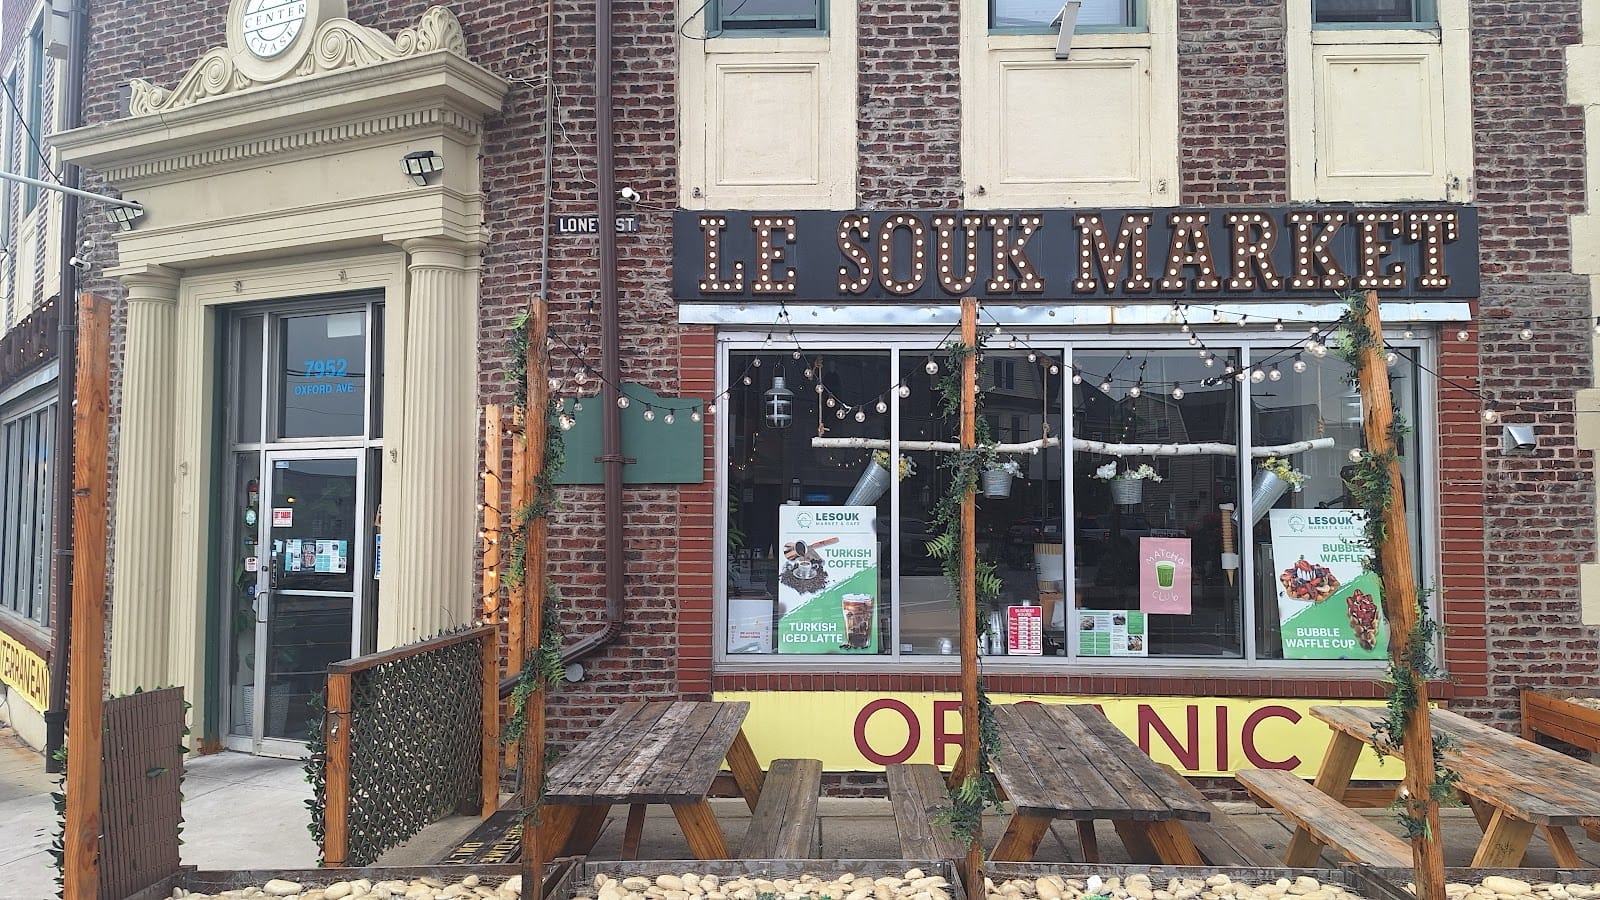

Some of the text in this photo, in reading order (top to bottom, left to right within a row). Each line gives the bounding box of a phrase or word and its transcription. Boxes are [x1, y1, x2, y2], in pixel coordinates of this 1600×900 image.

[245, 4, 305, 28] CENTER
[250, 27, 296, 53] CHASE
[615, 217, 637, 232] ST.
[699, 209, 1459, 295] LE SOUK MARKET
[304, 356, 347, 378] 7952
[294, 383, 332, 396] OXFORD
[815, 512, 860, 521] LESOUK
[1308, 516, 1353, 525] LESOUK
[1322, 543, 1365, 552] BUBBLE
[825, 548, 872, 558] TURKISH
[828, 559, 869, 569] COFFEE
[789, 622, 837, 632] TURKISH
[1296, 627, 1341, 637] BUBBLE
[782, 633, 843, 643] ICED LATTE
[1286, 639, 1356, 649] WAFFLE CUP
[853, 698, 1303, 773] ORNIC
